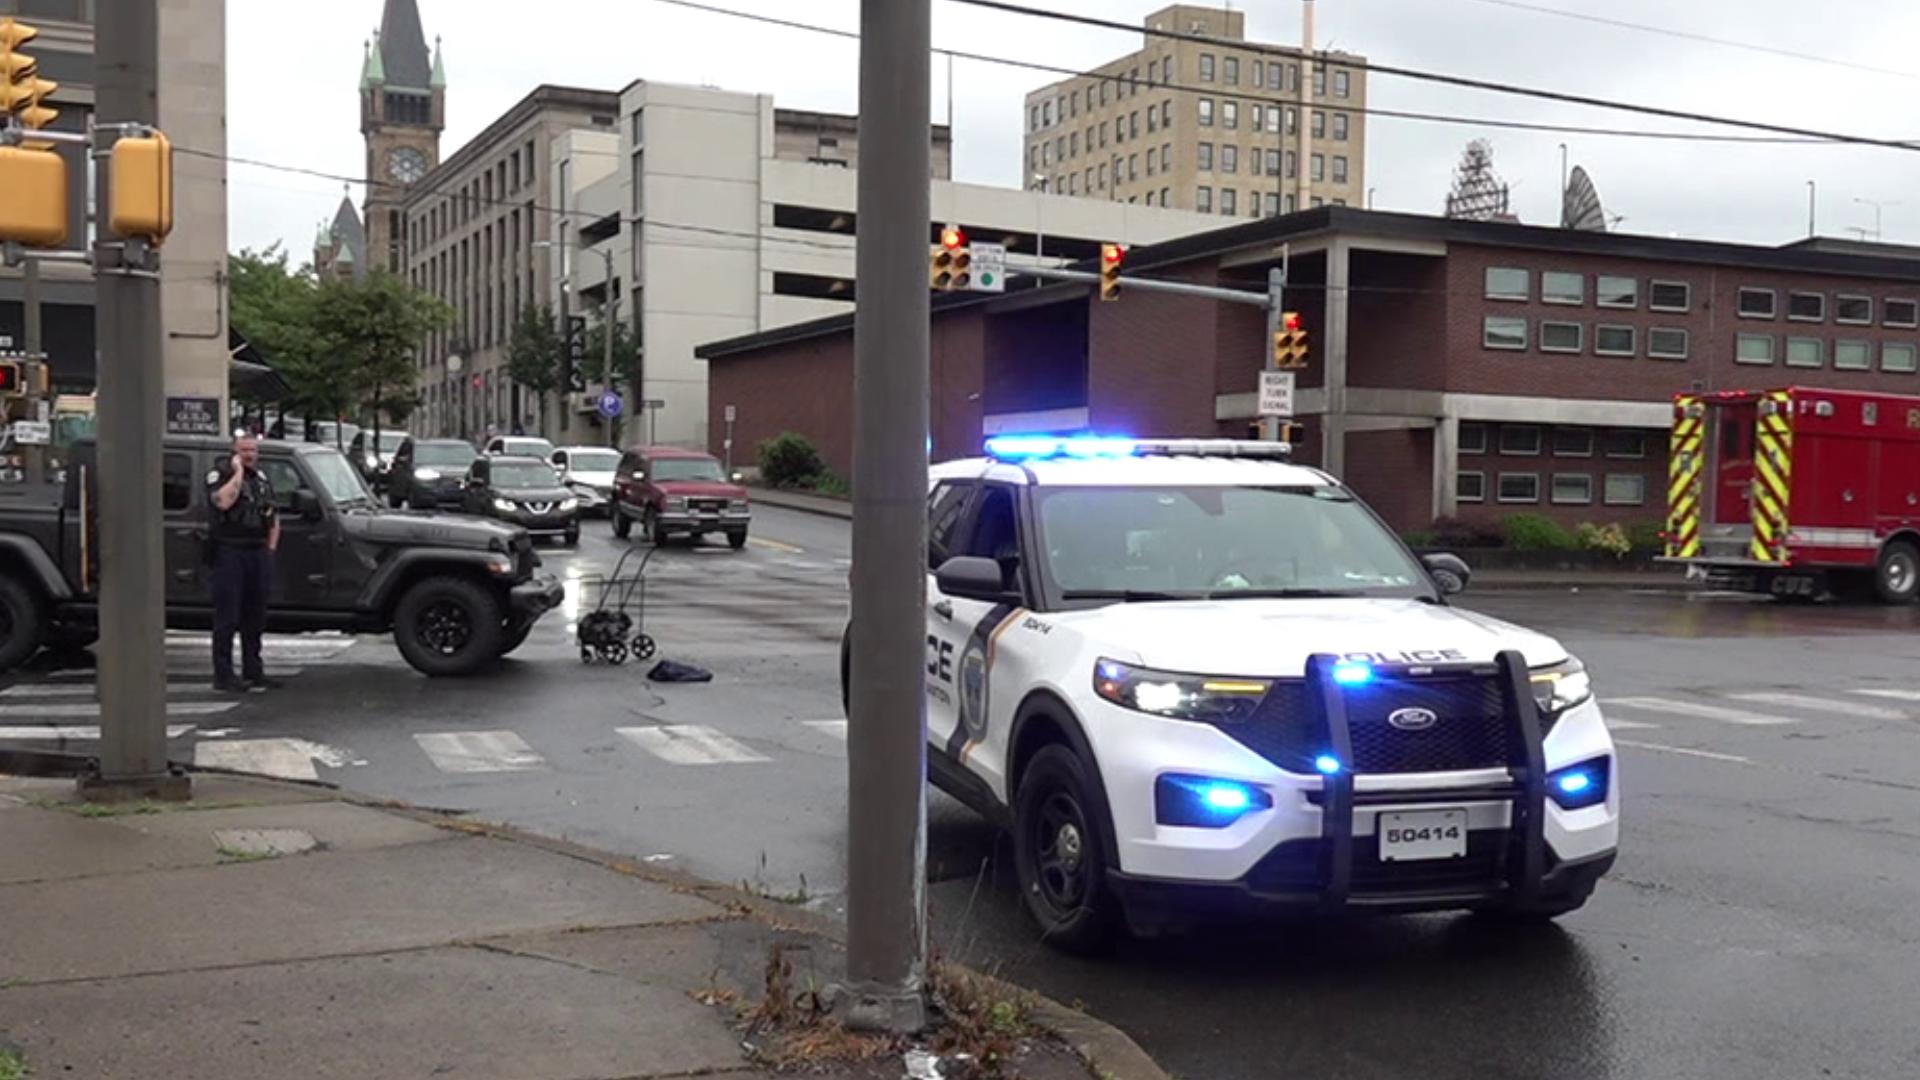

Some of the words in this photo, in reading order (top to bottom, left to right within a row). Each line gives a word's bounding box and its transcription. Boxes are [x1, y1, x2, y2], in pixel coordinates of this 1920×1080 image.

[183, 402, 203, 411] THE
[176, 411, 212, 422] GUILD
[168, 422, 219, 433] BUILDING
[1326, 649, 1467, 664] OLICE
[1386, 825, 1460, 844] 50414
